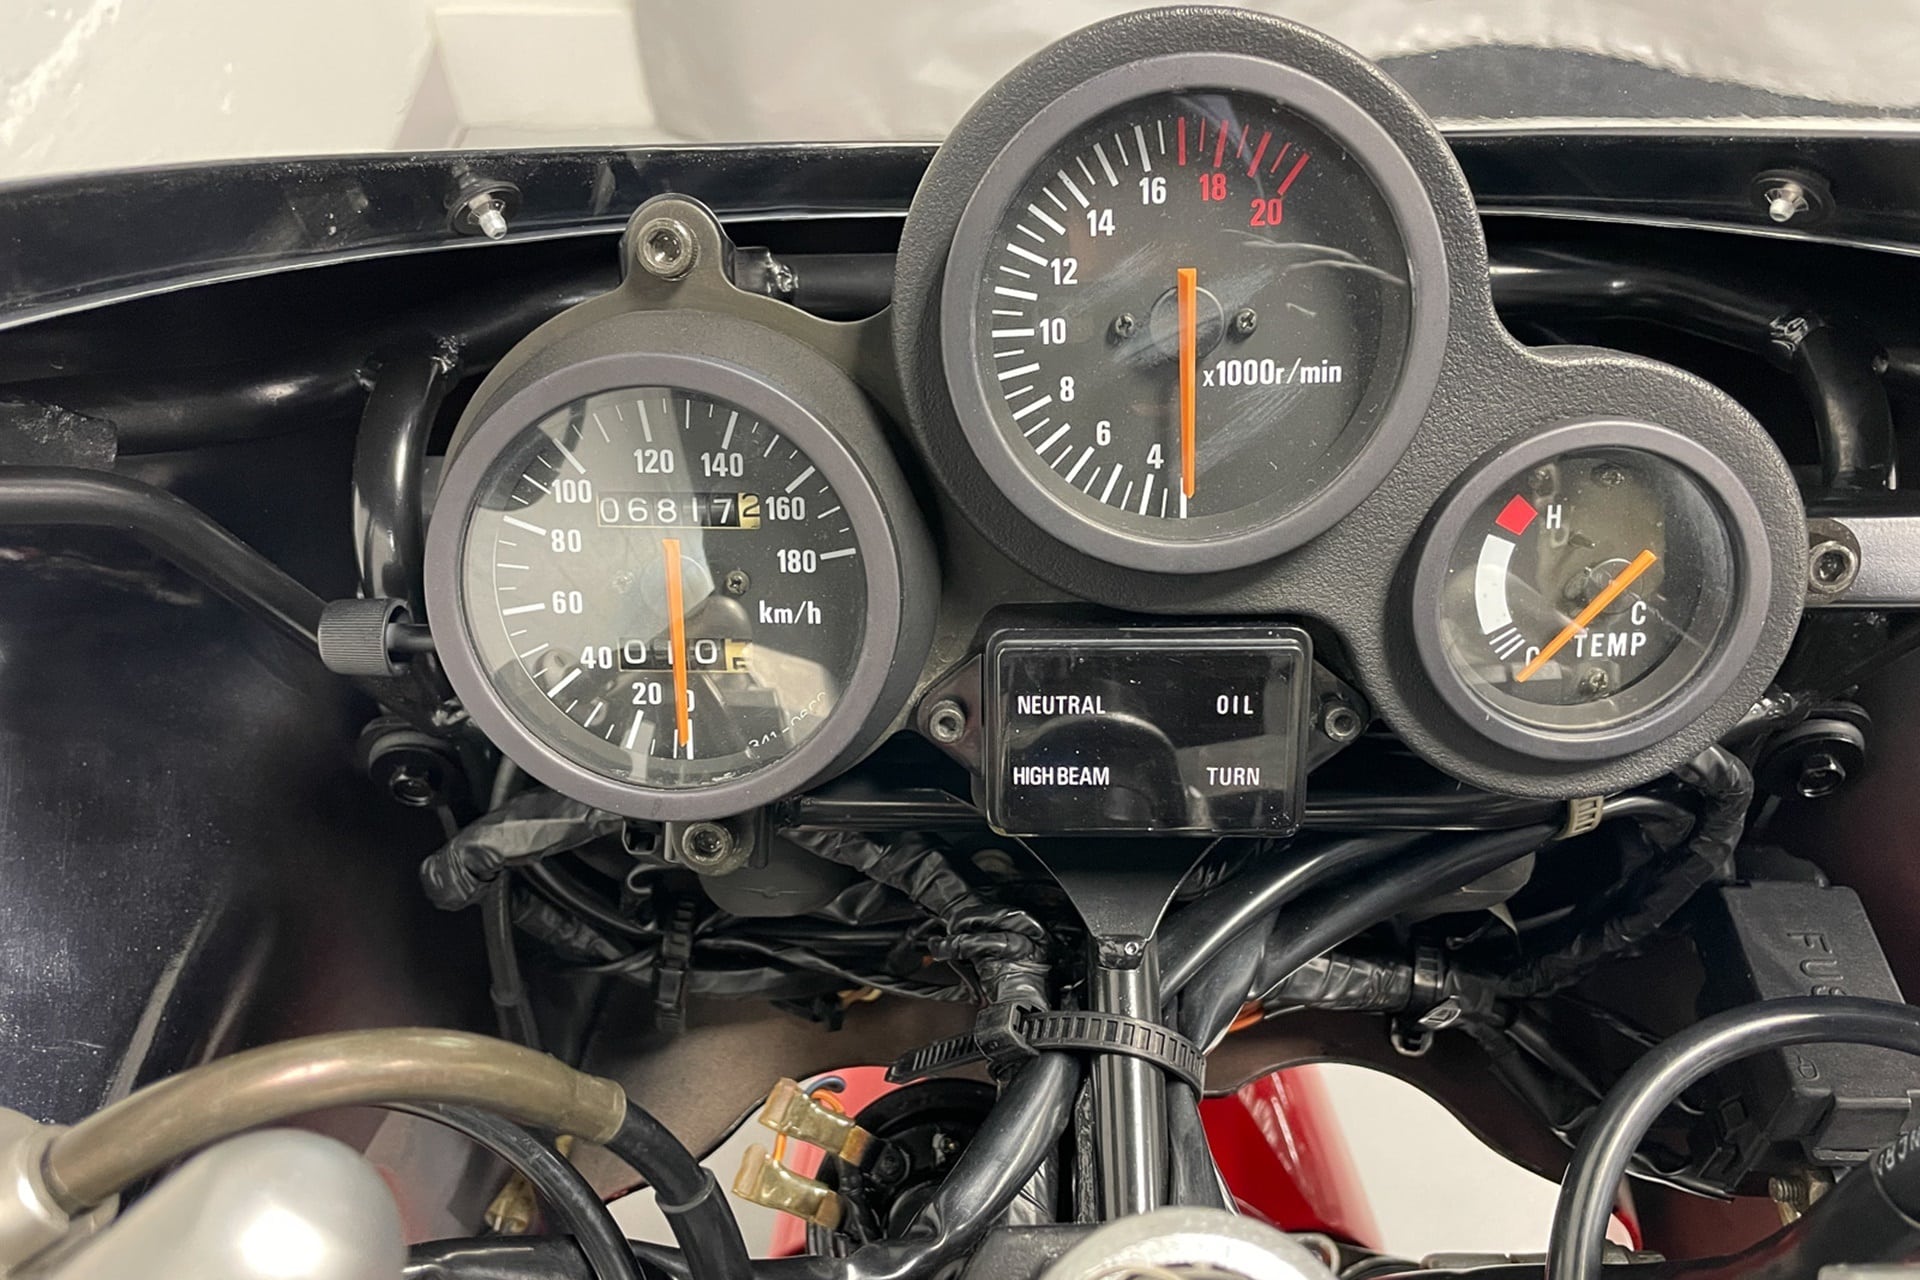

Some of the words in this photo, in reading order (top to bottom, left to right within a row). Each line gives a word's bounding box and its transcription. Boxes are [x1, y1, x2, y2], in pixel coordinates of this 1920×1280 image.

[1139, 177, 1166, 204] 16
[1201, 174, 1226, 201] 18
[1087, 209, 1115, 236] 14
[1250, 199, 1282, 225] 20
[1051, 258, 1078, 285] 12
[1040, 319, 1066, 344] 10
[1060, 377, 1074, 400] 8
[1096, 421, 1110, 445] 6
[634, 450, 674, 473] 120
[701, 453, 743, 477] 140
[1146, 445, 1163, 468] 4
[552, 480, 591, 503] 100
[766, 497, 805, 520] 160
[1546, 505, 1562, 529] H
[551, 529, 581, 553] 80
[777, 550, 816, 573] 180
[552, 591, 583, 614] 60
[759, 601, 821, 625] km/h
[1631, 601, 1646, 626] C
[1574, 633, 1646, 657] TEMP
[580, 646, 612, 669] 40
[632, 682, 661, 705] 20
[1017, 695, 1106, 715] NEUTRAL
[1216, 694, 1254, 715] OIL
[1013, 766, 1054, 785] HIGH
[1057, 766, 1110, 785] BEAM
[1206, 766, 1260, 785] TURN
